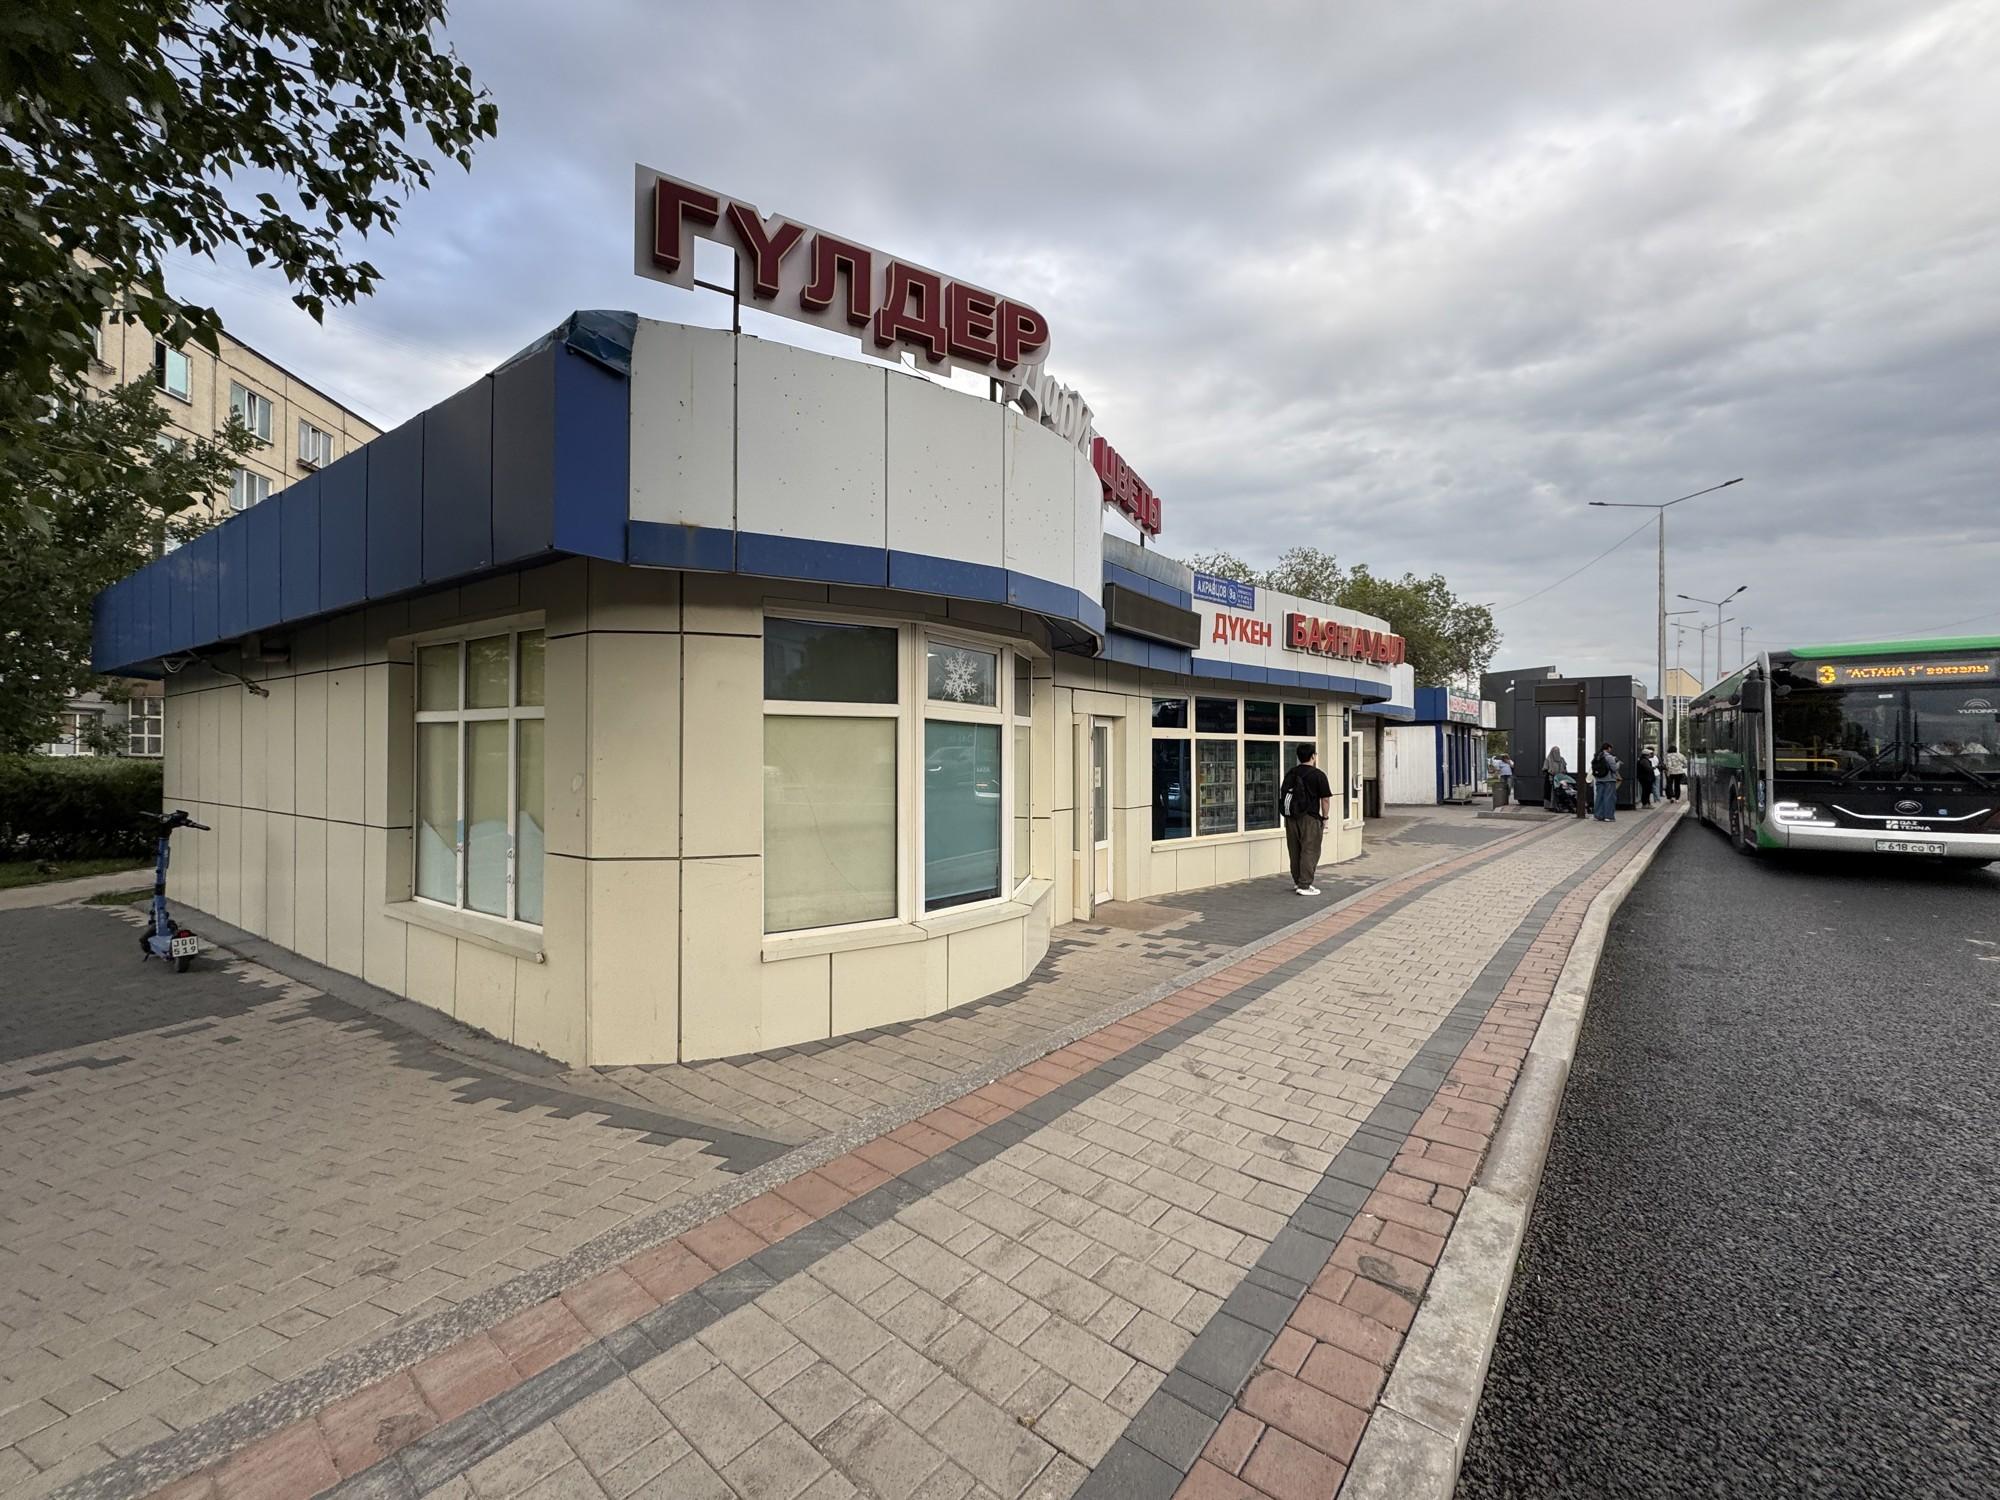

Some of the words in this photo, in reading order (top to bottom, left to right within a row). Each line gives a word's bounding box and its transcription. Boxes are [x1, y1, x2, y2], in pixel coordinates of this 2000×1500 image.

[1093, 437, 1161, 535] ЦВЕТЫ
[1287, 613, 1406, 666] БАЯНАУЫЛ
[1818, 665, 1836, 684] 3
[1926, 664, 1989, 676] вокзалы
[1888, 843, 1908, 851] 618
[1928, 844, 1943, 852] 01
[174, 945, 196, 955] 519
